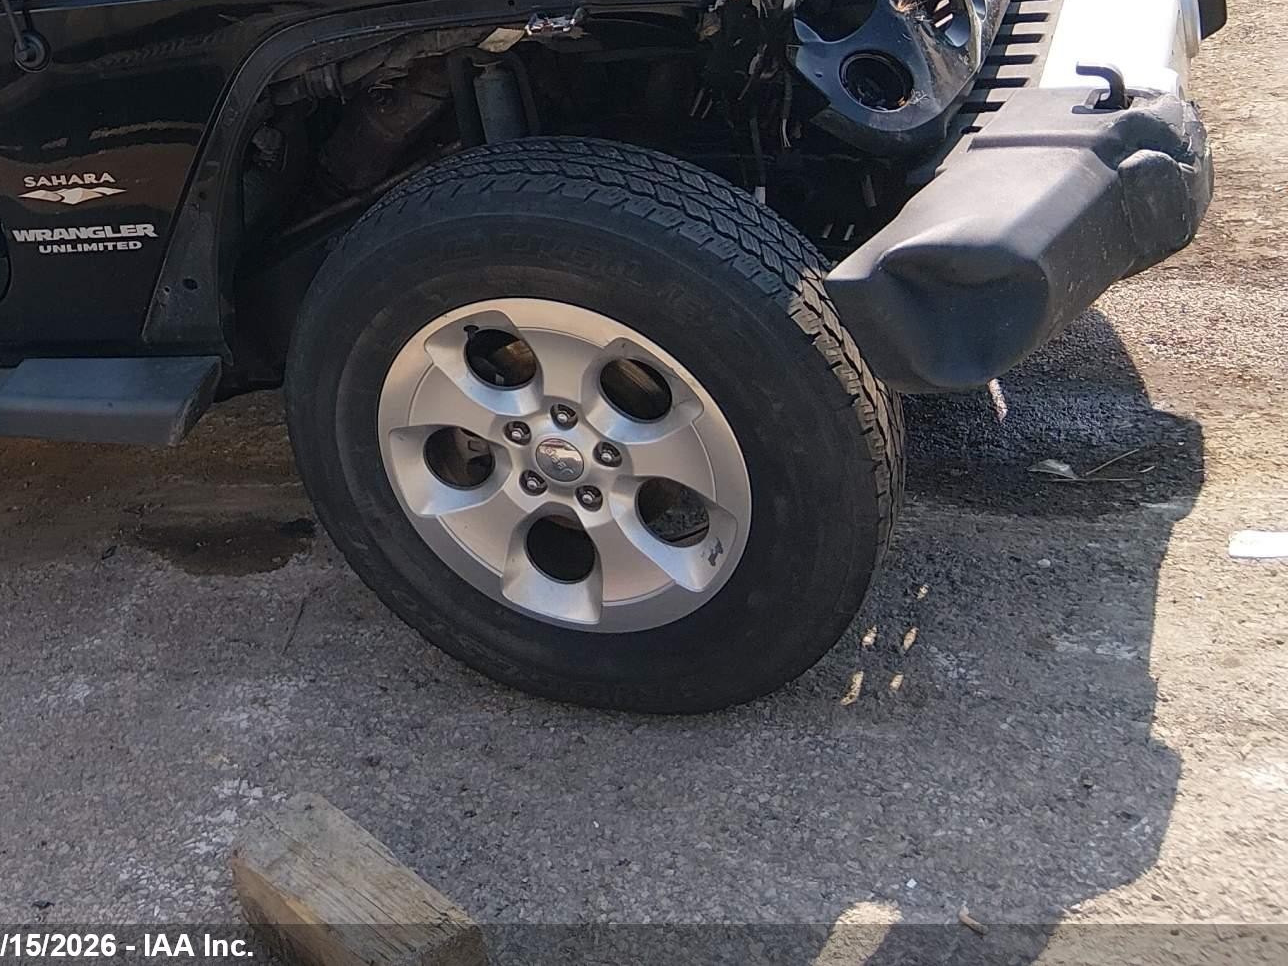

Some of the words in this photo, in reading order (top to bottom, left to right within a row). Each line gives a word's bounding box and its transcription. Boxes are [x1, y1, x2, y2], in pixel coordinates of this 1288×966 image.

[23, 172, 115, 187] SAHARA
[12, 224, 158, 242] WRANGLER
[39, 241, 143, 254] UNLIMITED
